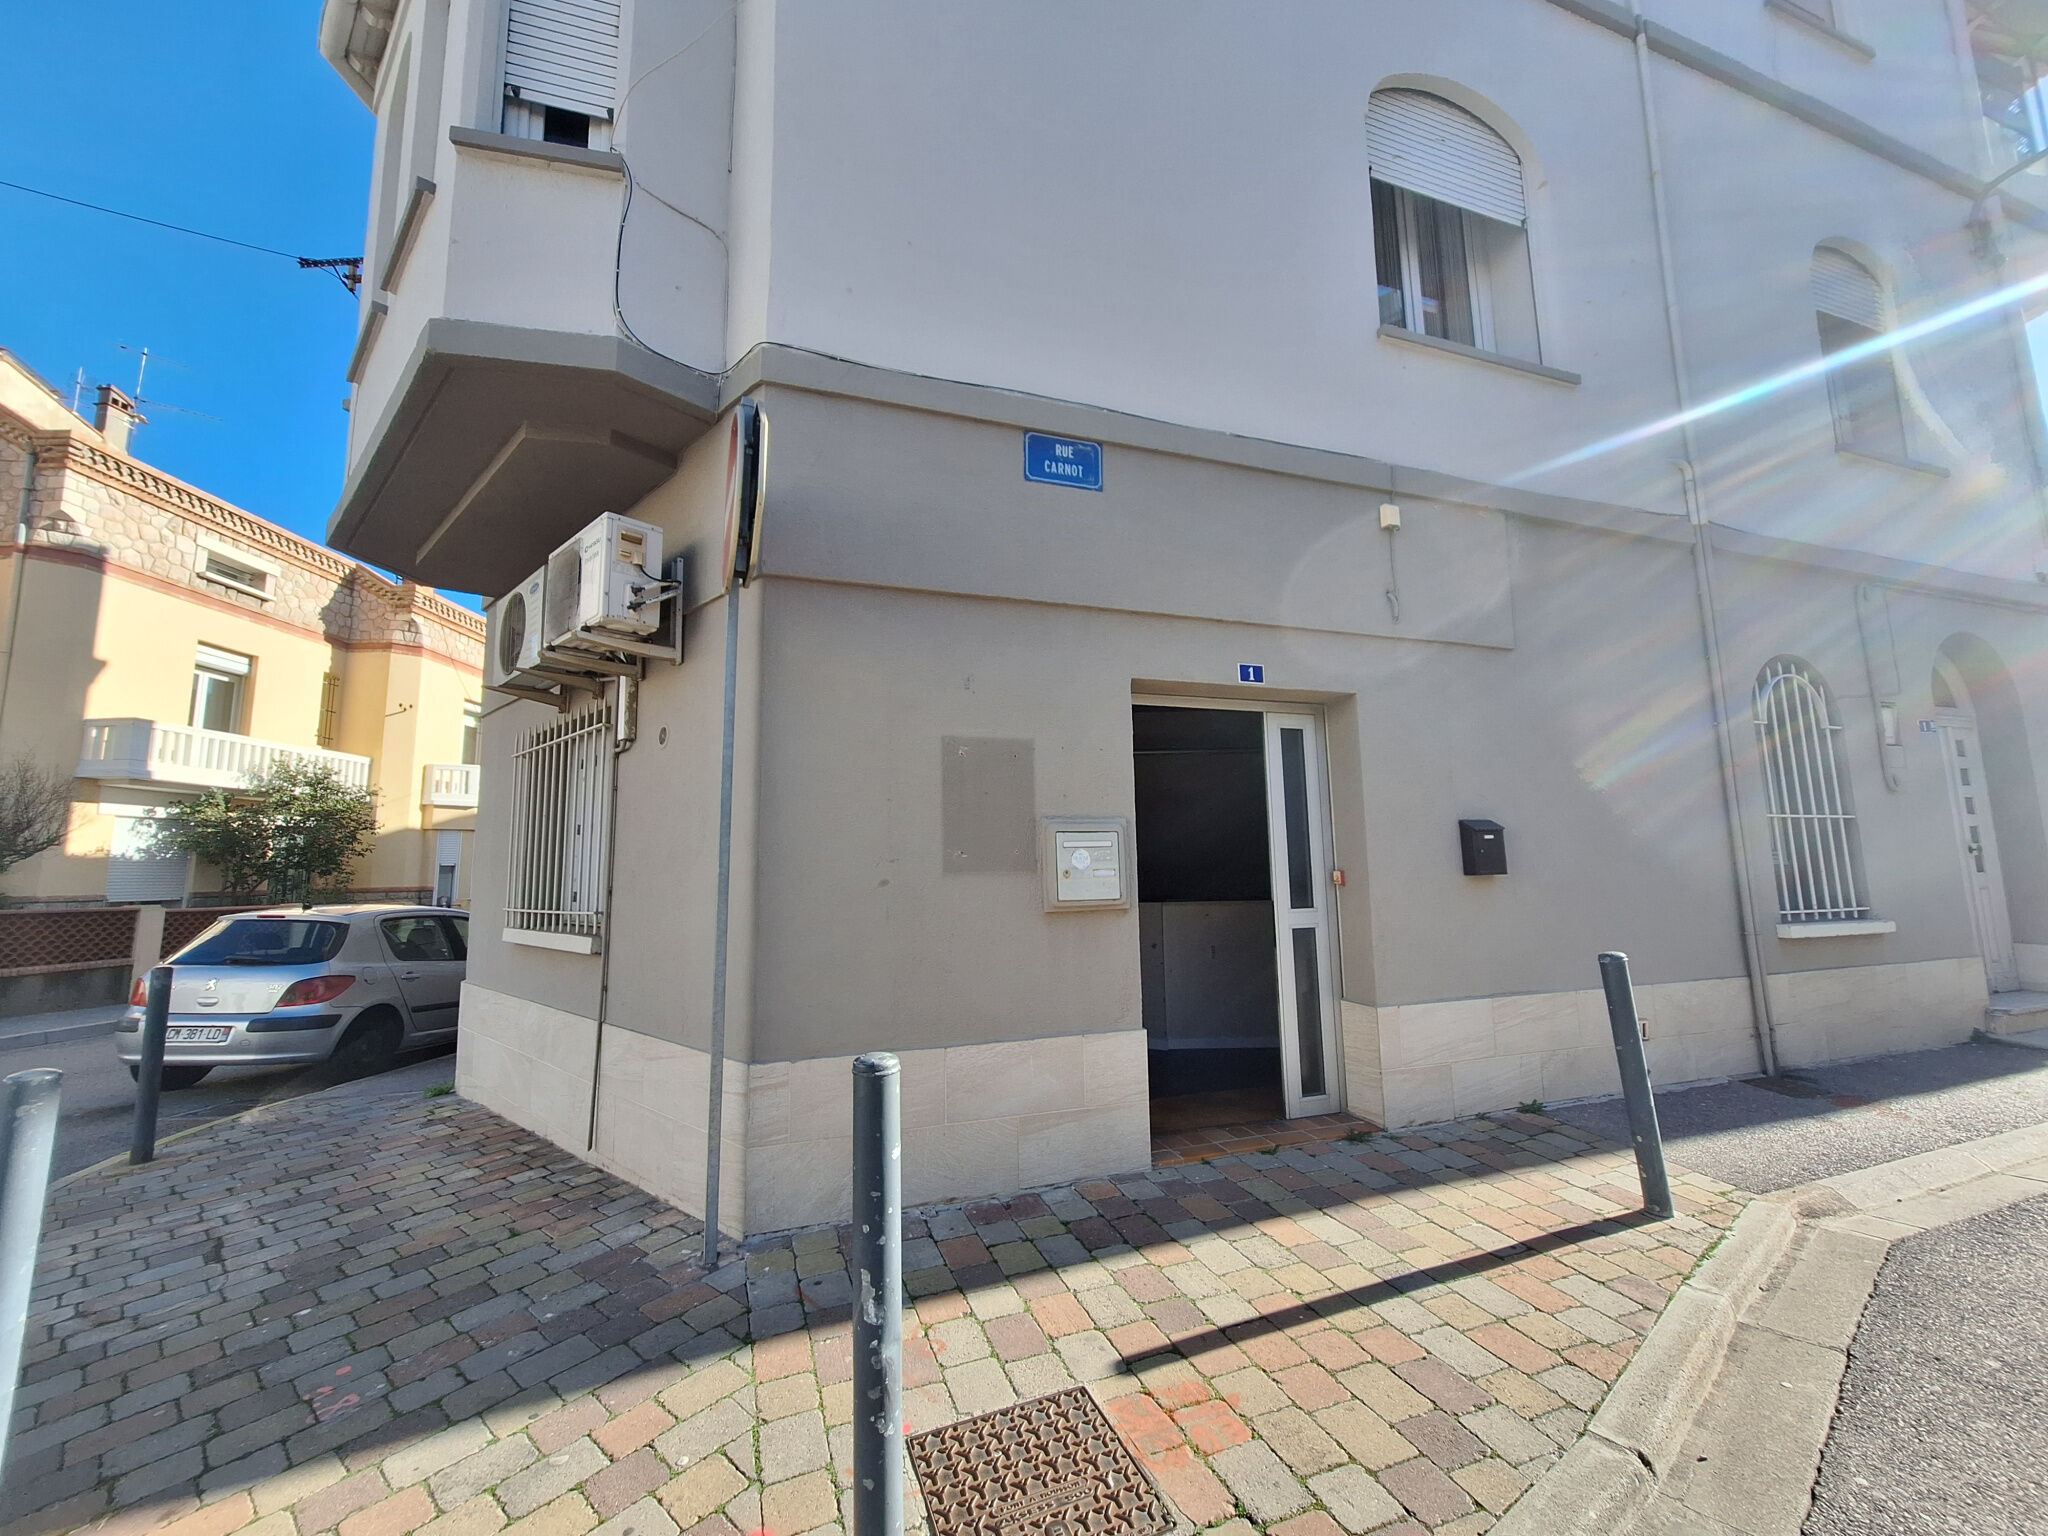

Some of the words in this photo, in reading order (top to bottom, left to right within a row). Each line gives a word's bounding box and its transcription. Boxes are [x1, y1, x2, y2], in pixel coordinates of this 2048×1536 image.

[1055, 443, 1074, 459] RUE
[1044, 459, 1084, 478] CARNOT
[1247, 666, 1255, 681] 1
